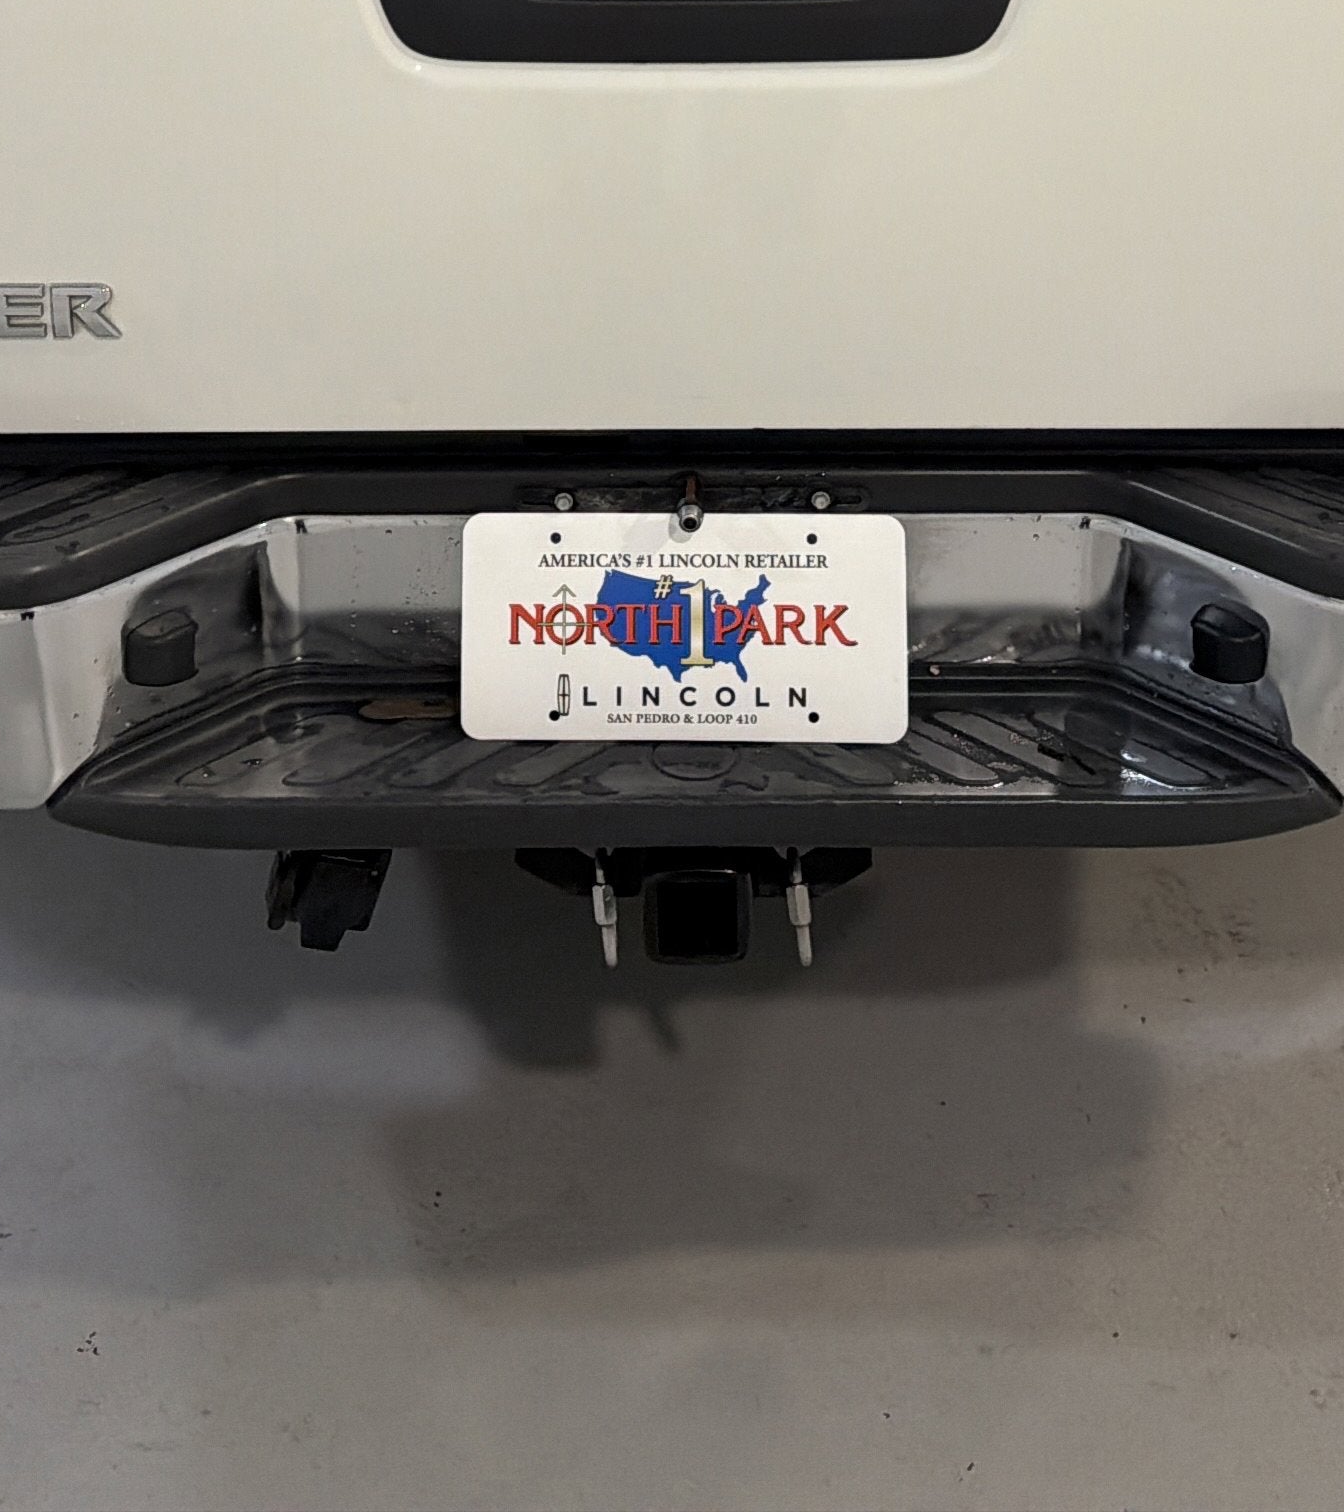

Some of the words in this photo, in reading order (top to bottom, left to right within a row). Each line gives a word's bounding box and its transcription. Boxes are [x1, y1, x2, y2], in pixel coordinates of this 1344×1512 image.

[538, 553, 632, 569] AMERICA'S
[635, 554, 654, 568] #1
[658, 553, 740, 569] LINCOLN
[744, 553, 829, 569] RETAILER
[508, 603, 683, 646] NORTH
[712, 603, 859, 647] PARK
[582, 686, 808, 708] LINCOLN
[607, 712, 633, 724] SAN
[636, 712, 681, 725] PEDRO
[683, 713, 695, 725] &
[697, 713, 734, 725] LOOP
[735, 713, 757, 725] 410
